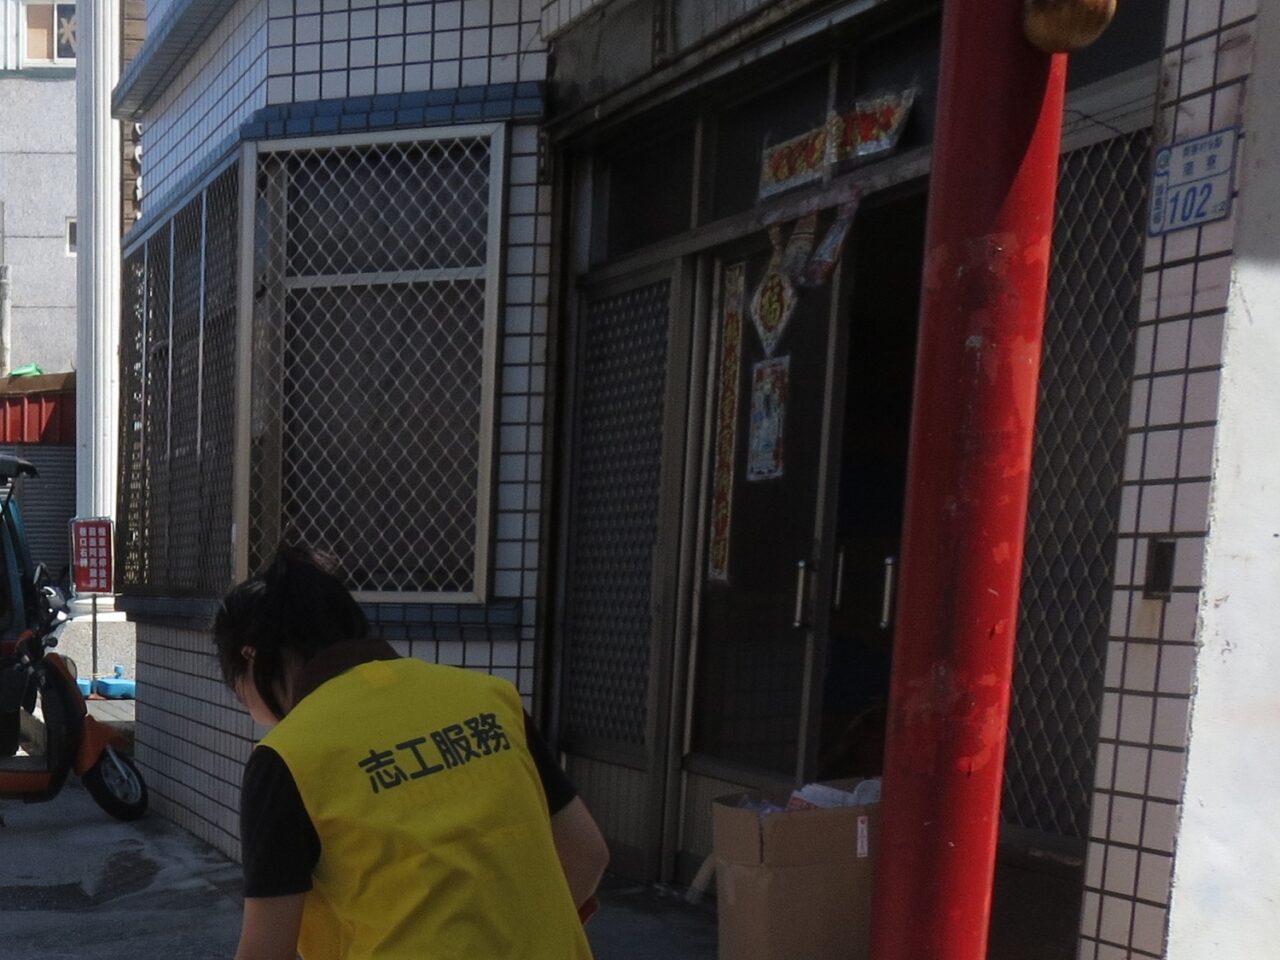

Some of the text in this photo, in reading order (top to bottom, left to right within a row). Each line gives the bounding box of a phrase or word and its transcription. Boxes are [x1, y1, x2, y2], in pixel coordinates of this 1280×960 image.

[1169, 182, 1213, 224] 102
[357, 712, 511, 794] 志工服務
